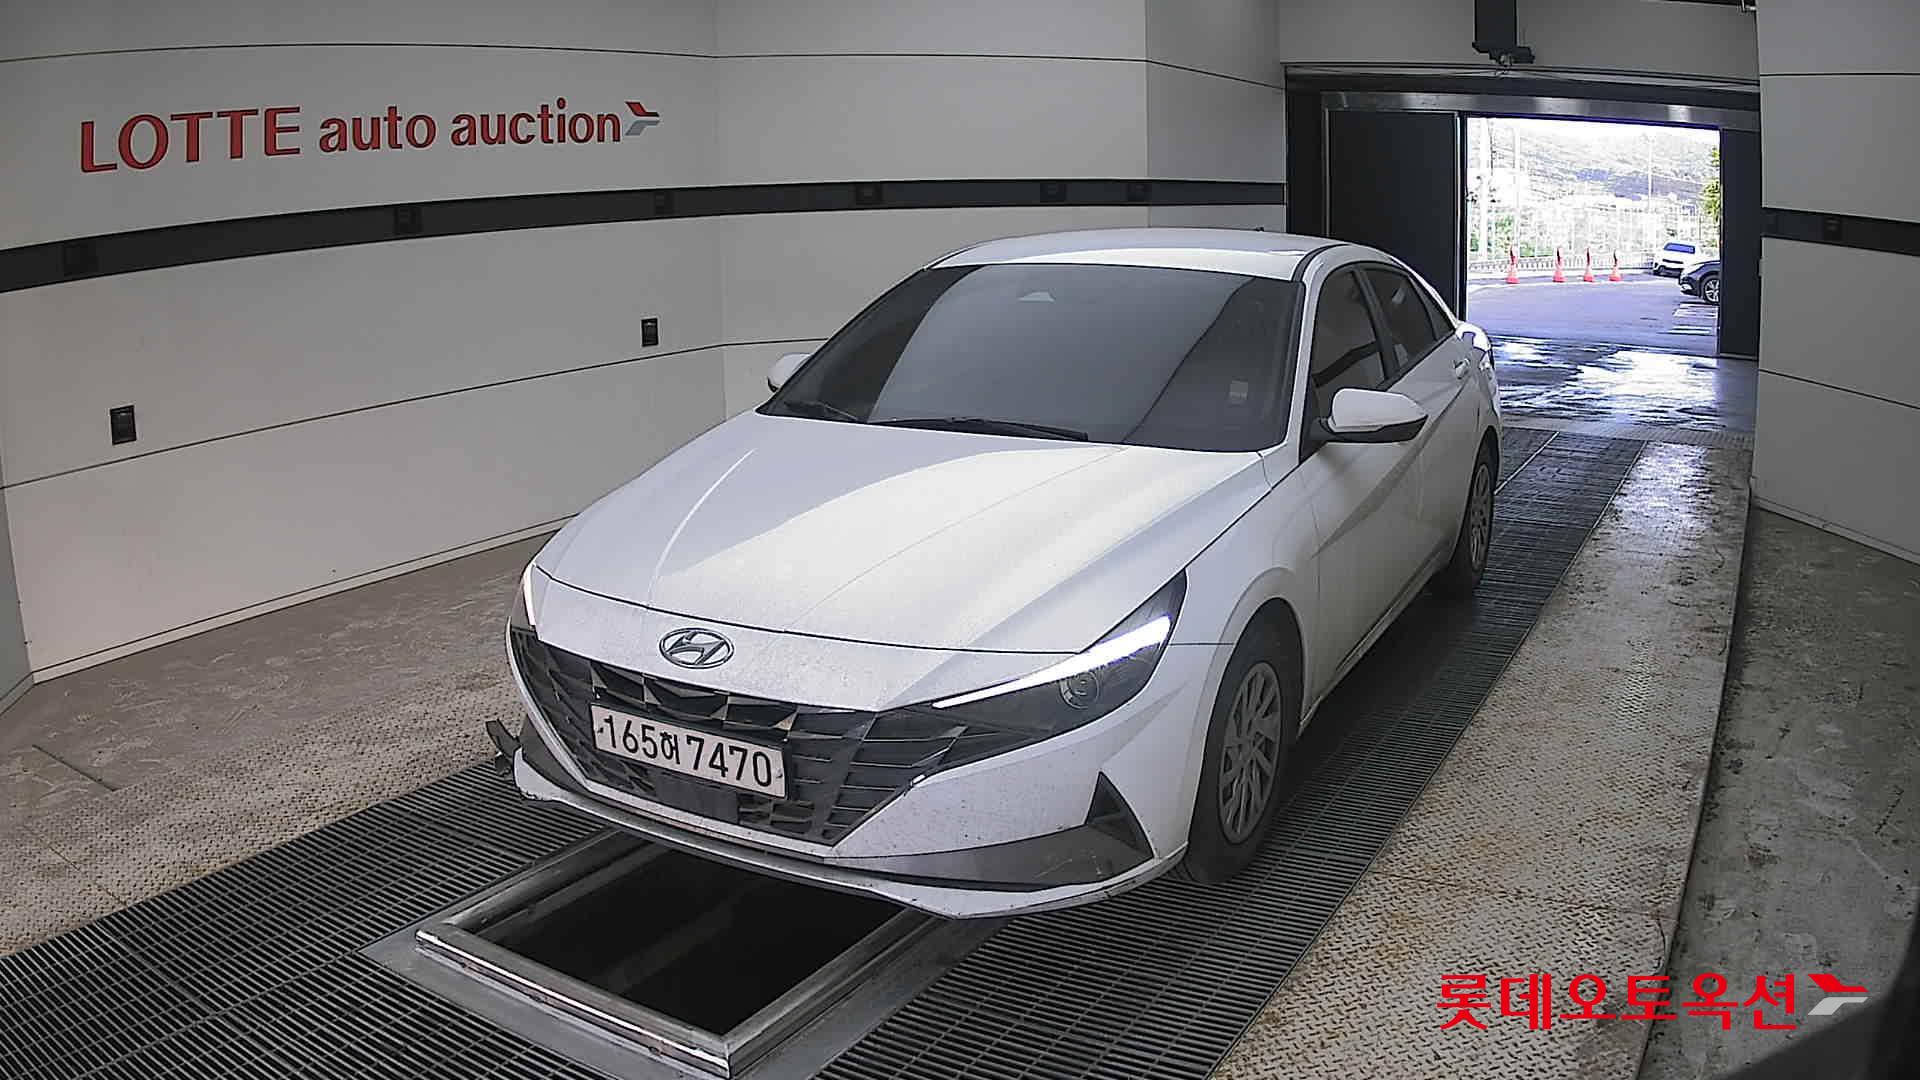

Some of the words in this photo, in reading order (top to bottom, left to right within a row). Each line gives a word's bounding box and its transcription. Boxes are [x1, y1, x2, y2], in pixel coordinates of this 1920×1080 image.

[80, 106, 301, 173] LOTTE
[319, 106, 437, 153] auto
[451, 98, 622, 146] auction
[686, 734, 772, 787] 7470
